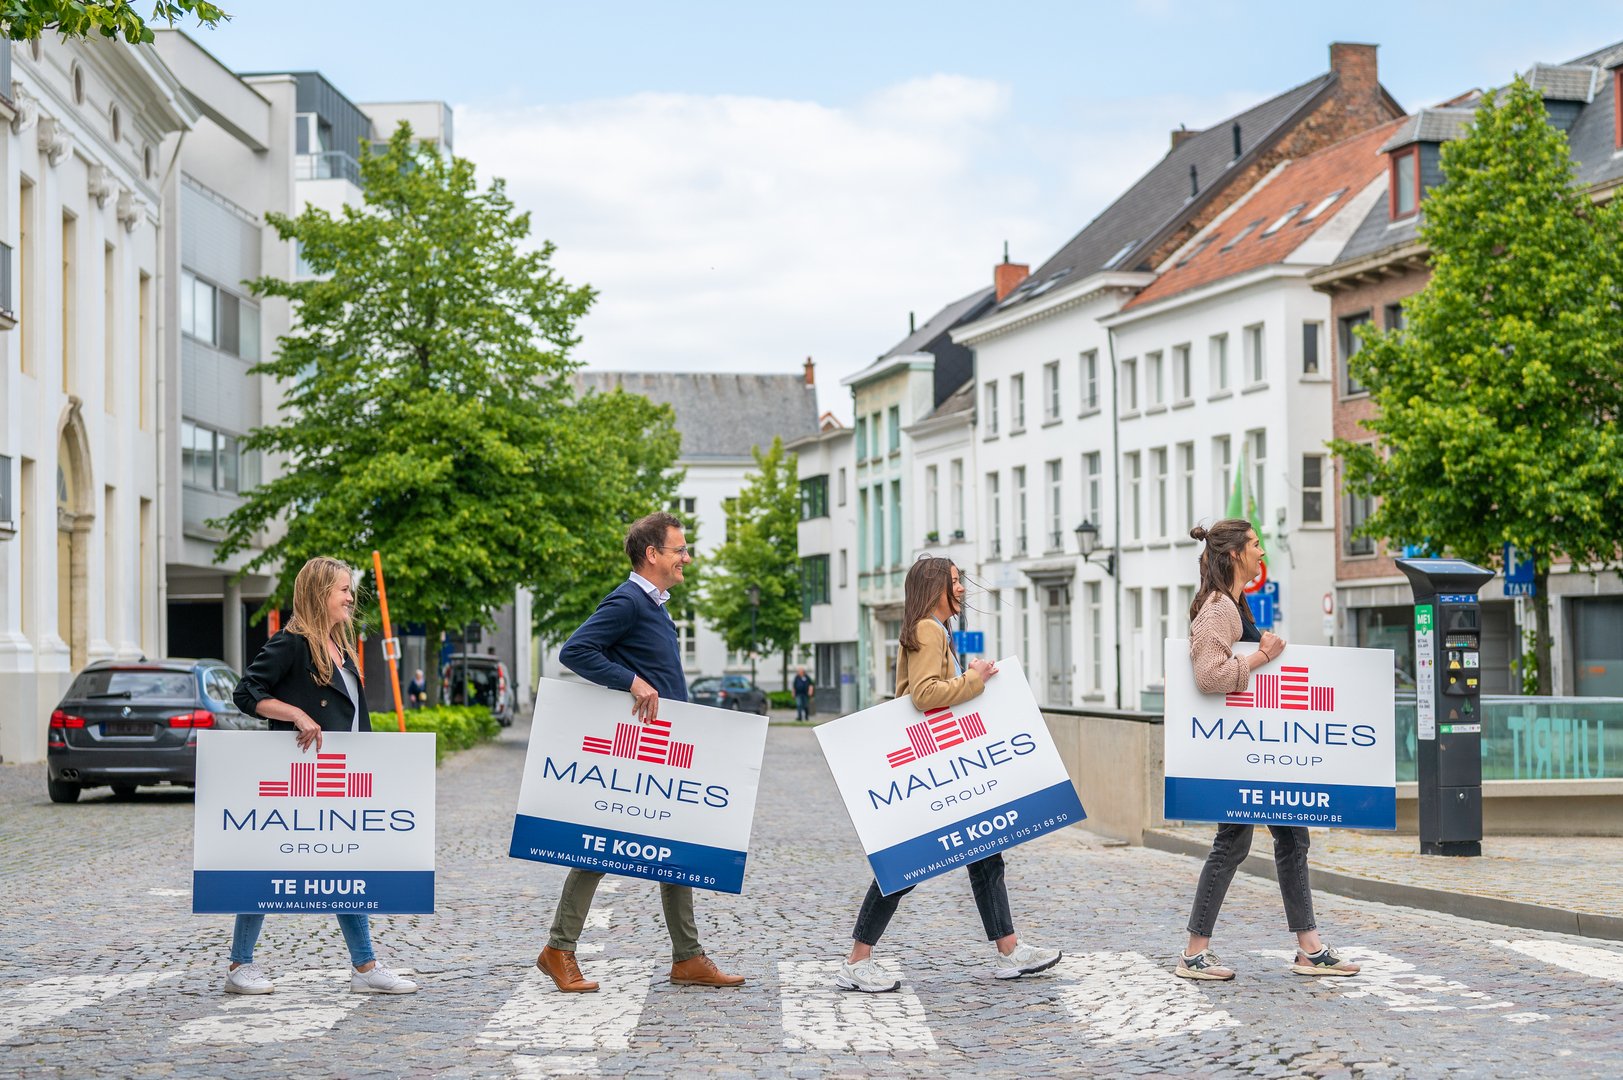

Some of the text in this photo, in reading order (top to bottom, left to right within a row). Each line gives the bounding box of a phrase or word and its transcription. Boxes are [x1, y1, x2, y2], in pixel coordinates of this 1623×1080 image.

[1507, 583, 1532, 596] TAXI
[1417, 614, 1431, 625] ME1
[1192, 716, 1377, 747] MALINES
[1246, 753, 1323, 767] GROUP
[543, 756, 729, 808] MALINES
[867, 733, 1037, 810] MALINES
[930, 779, 998, 812] GROUP
[1238, 788, 1330, 808] TE HUUR
[223, 808, 416, 832] MALINES
[594, 800, 672, 821] GROUP
[1226, 810, 1342, 823] WWW.MALINES-GROUP.BE
[937, 809, 1019, 851] TE KOOP
[279, 842, 360, 854] GROUP
[581, 833, 672, 862] TE KOOP
[903, 835, 1009, 881] WWW.MALINES-GROUP.BE
[1016, 827, 1031, 838] 015
[1032, 823, 1042, 832] 21
[1043, 818, 1055, 828] 68
[1056, 813, 1068, 823] 50
[530, 847, 649, 874] WWW.MALINES-GROUP.BE
[657, 868, 673, 878] 015
[675, 871, 686, 880] 21
[688, 873, 701, 883] 68
[703, 876, 716, 885] 50
[271, 879, 366, 895] TE HUUR
[257, 901, 379, 909] WWW.MALINES-GROUP.BE
